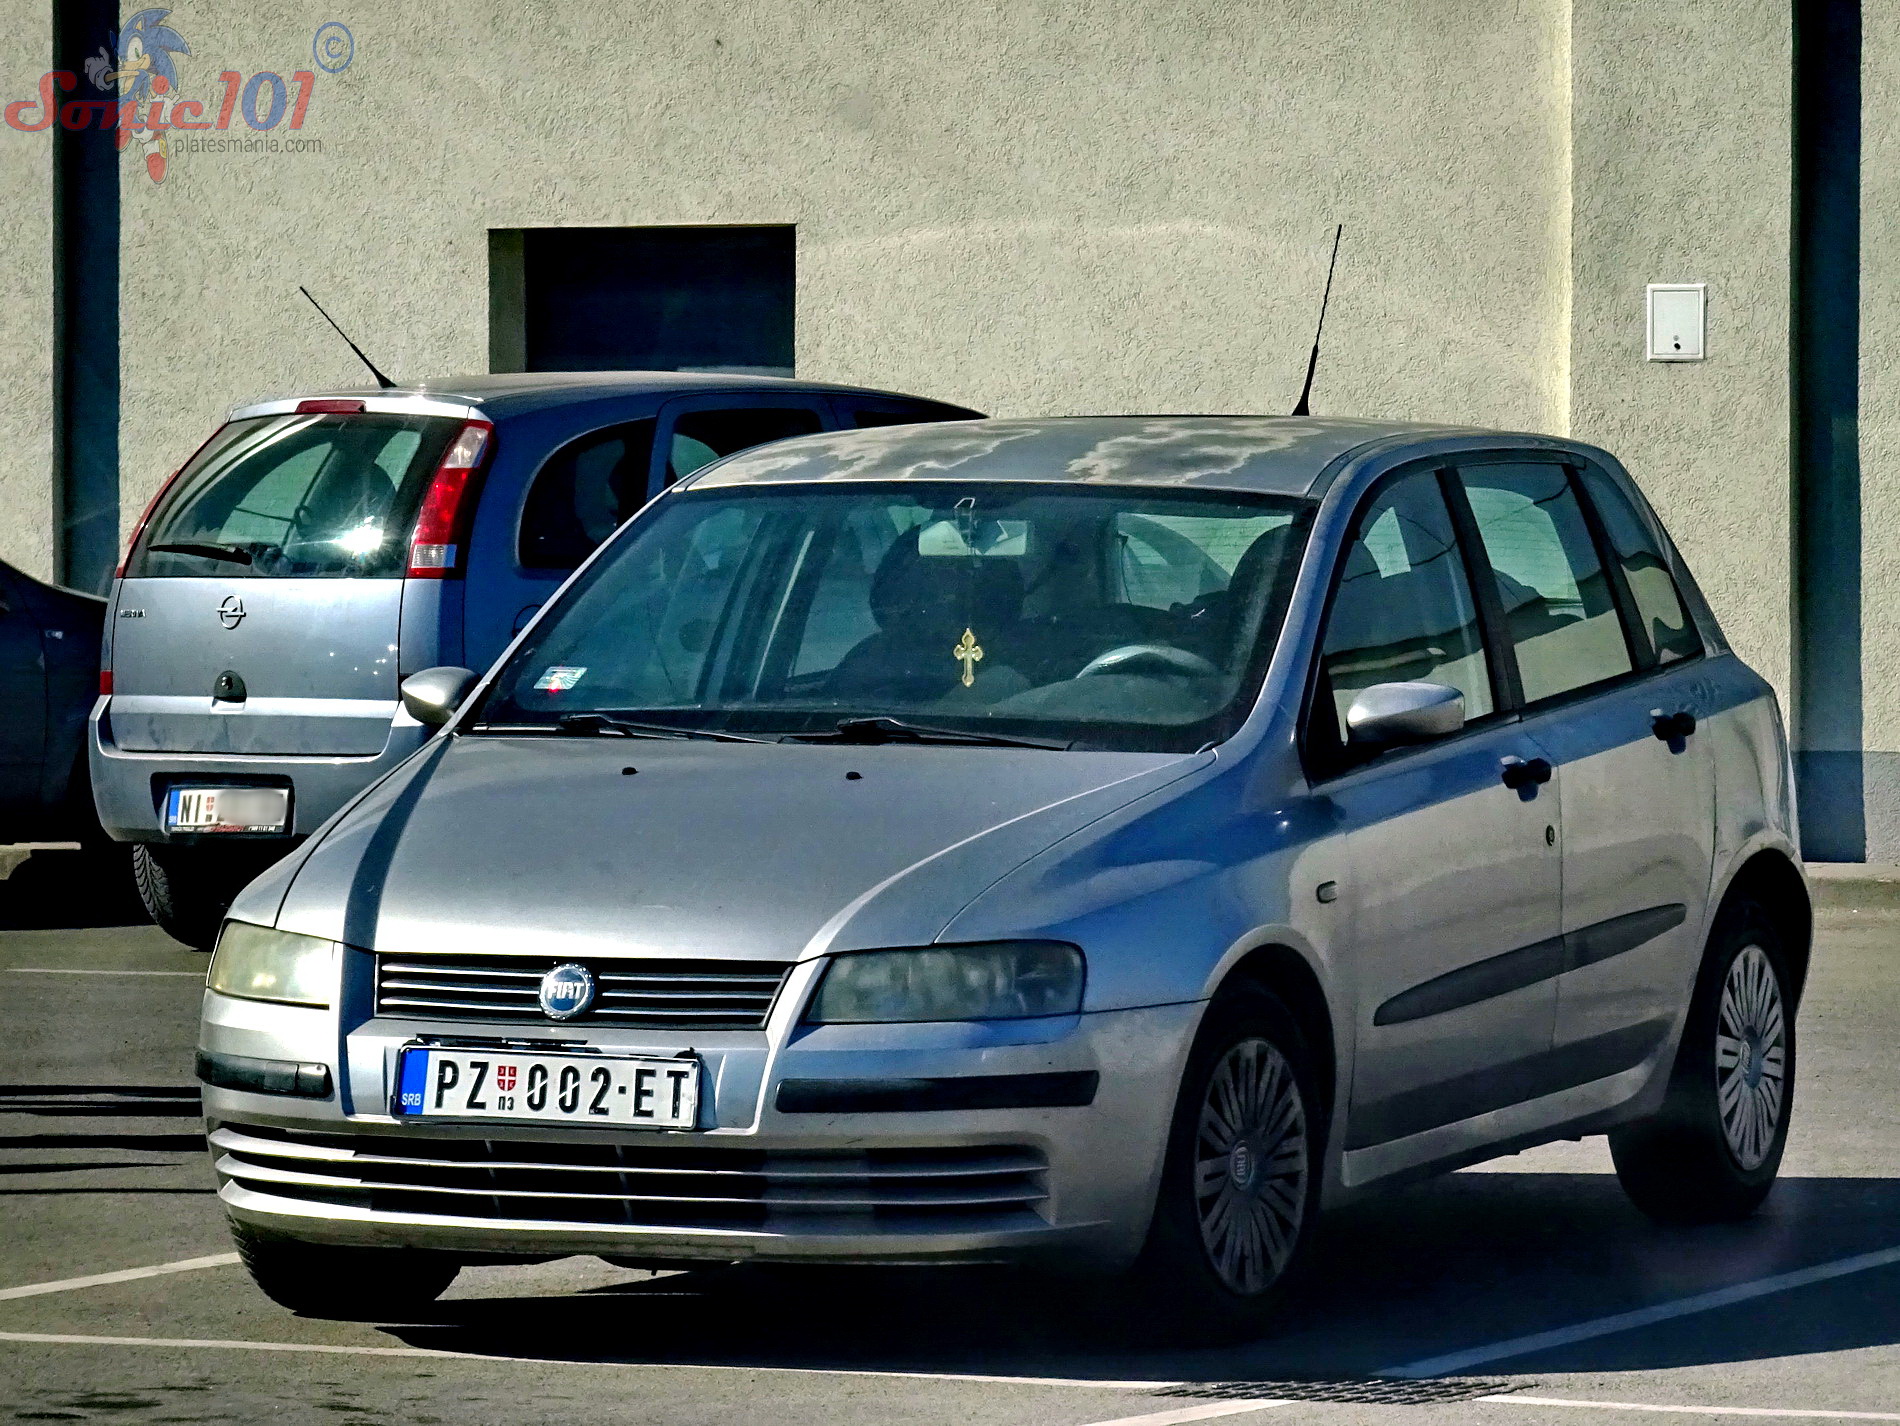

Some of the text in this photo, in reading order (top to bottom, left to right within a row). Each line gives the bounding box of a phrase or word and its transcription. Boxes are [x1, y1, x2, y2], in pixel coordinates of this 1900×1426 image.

[547, 981, 584, 999] FIAT
[434, 1059, 490, 1110] PZ
[401, 1092, 422, 1107] SRB
